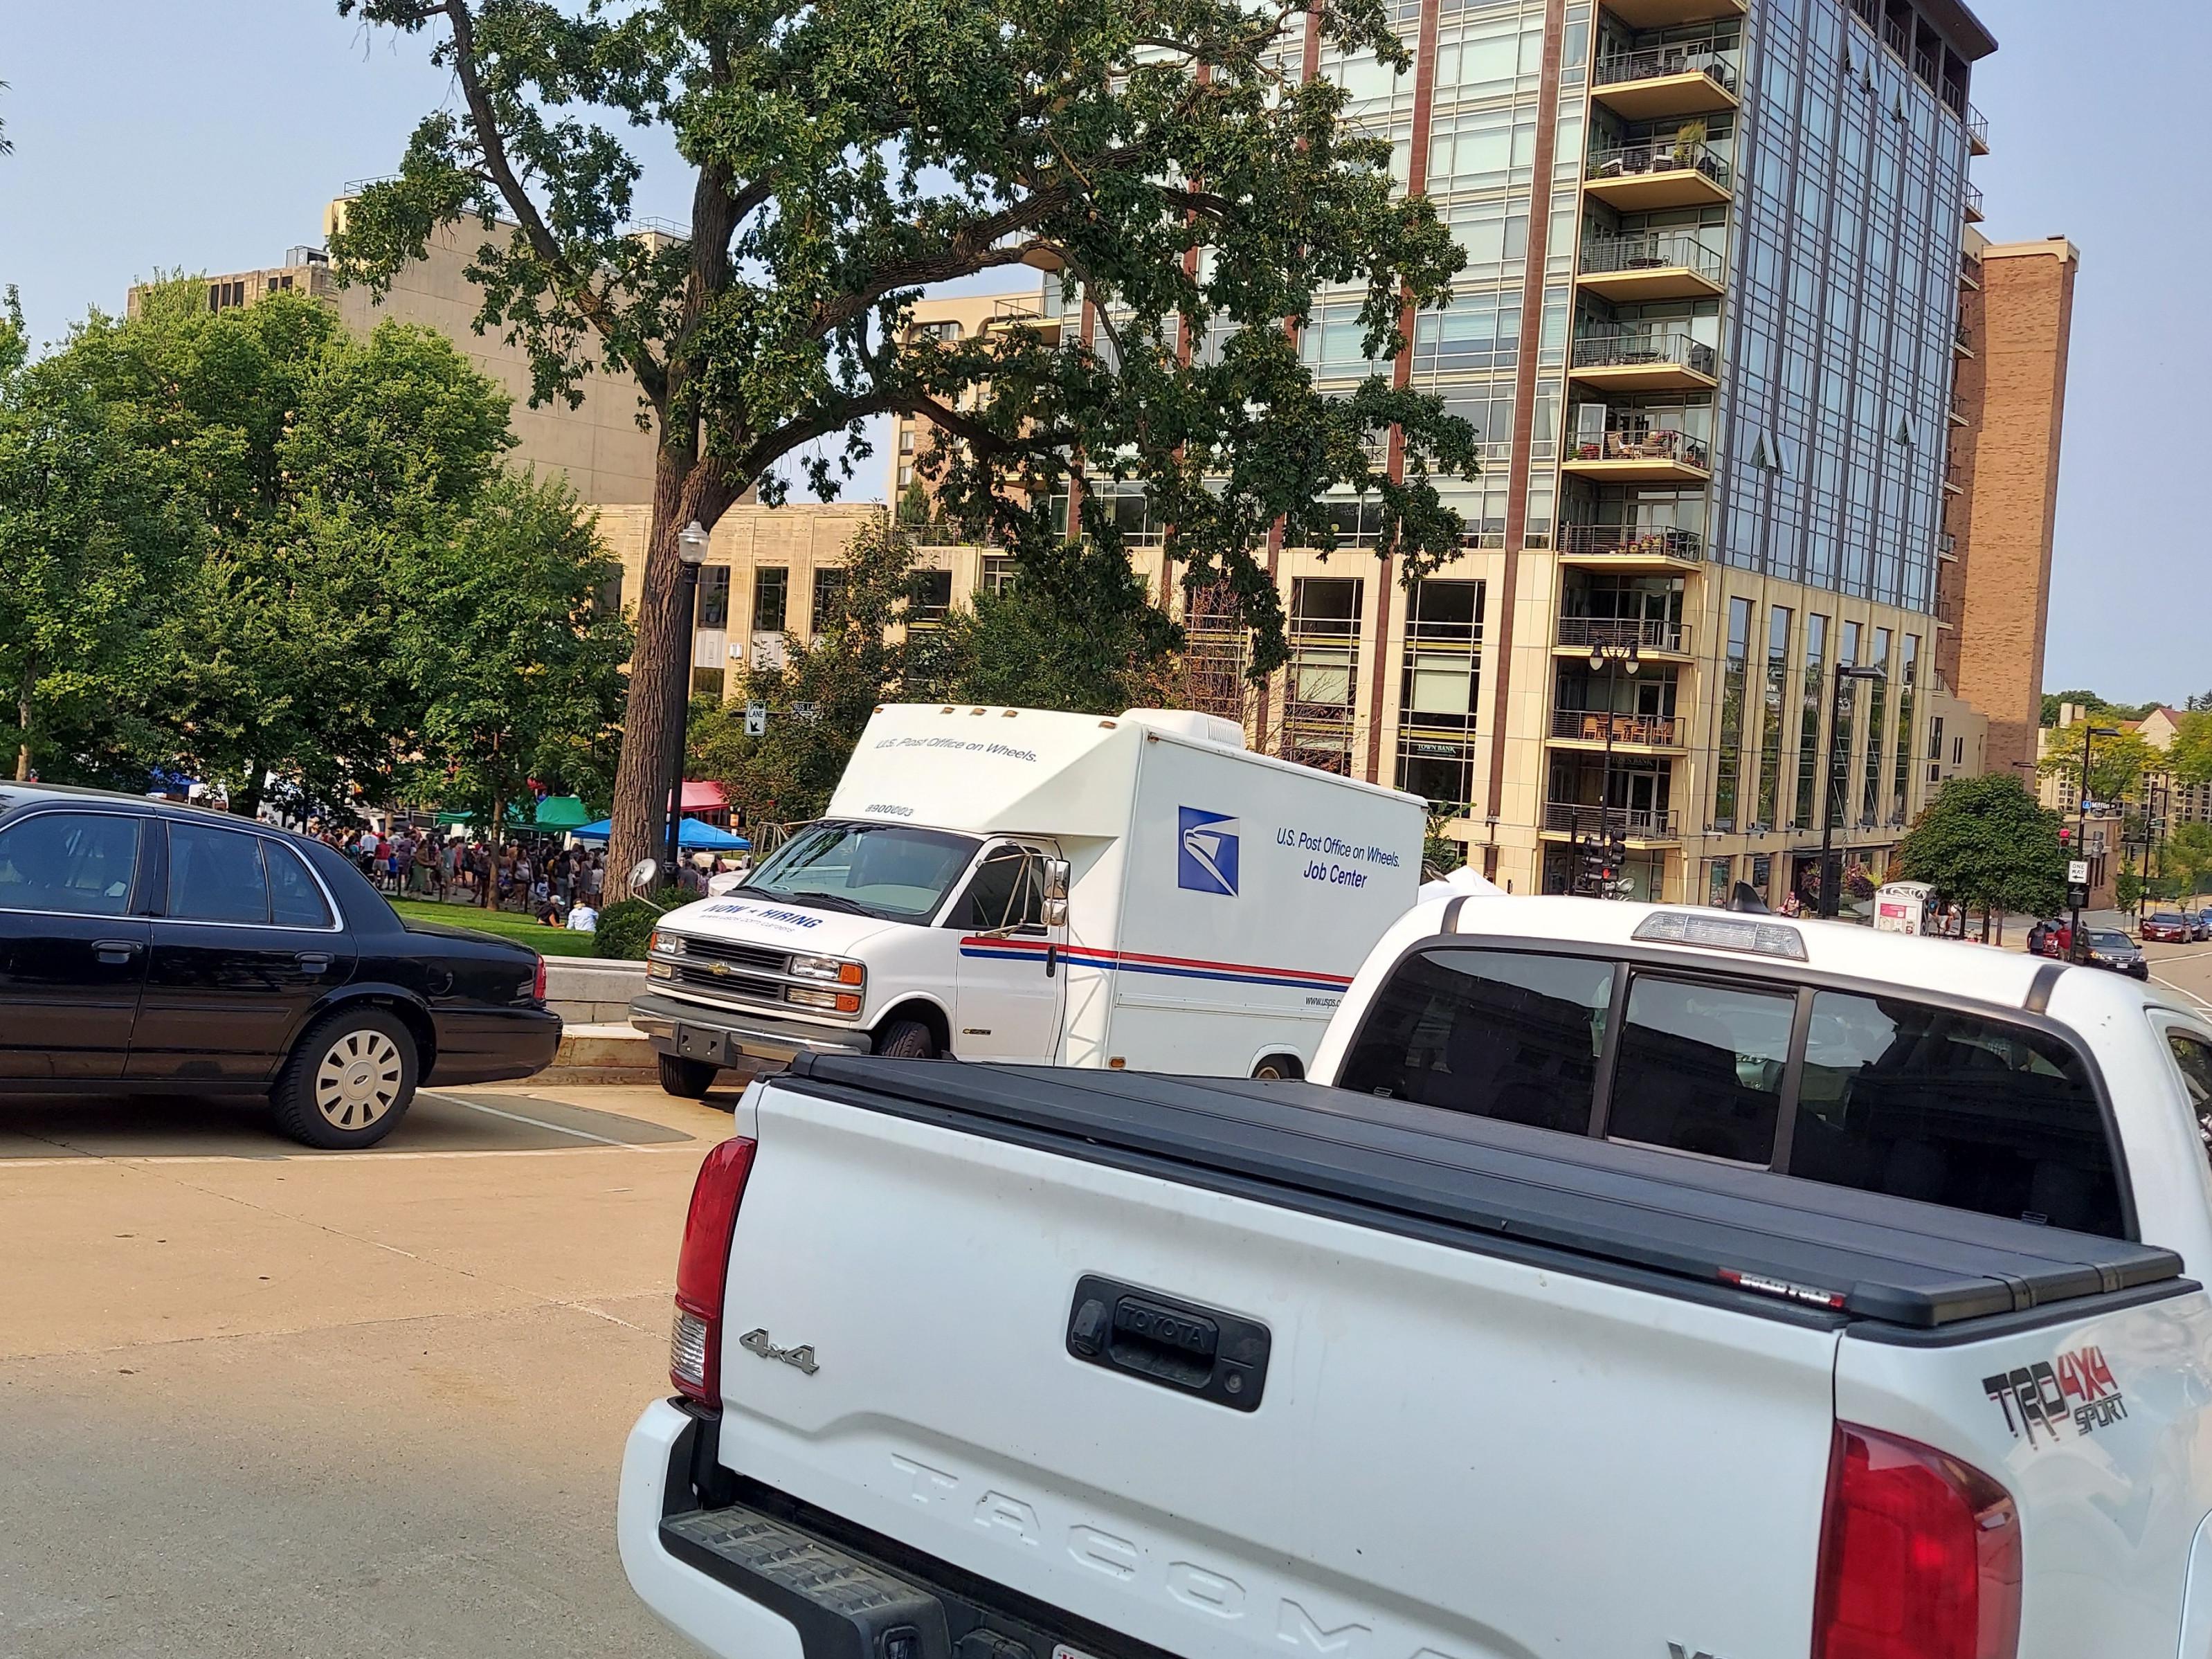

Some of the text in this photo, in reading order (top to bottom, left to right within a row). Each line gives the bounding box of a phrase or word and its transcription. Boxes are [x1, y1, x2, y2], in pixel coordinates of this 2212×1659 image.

[896, 738, 929, 747] Post
[927, 738, 966, 749] Office
[966, 743, 984, 752] on
[986, 743, 1037, 763] Wheels.
[1438, 745, 1456, 754] BANK
[1276, 827, 1400, 867] U.S. Post Office on Wheels.
[1303, 860, 1368, 889] Job Center
[702, 904, 823, 928] NOW HIRING
[1121, 1305, 1205, 1349] TOYOTA
[738, 1327, 820, 1377] 4x4
[1982, 1361, 2070, 1451] TRD
[2074, 1393, 2129, 1437] SPORT
[890, 1452, 1467, 1658] TACOM
